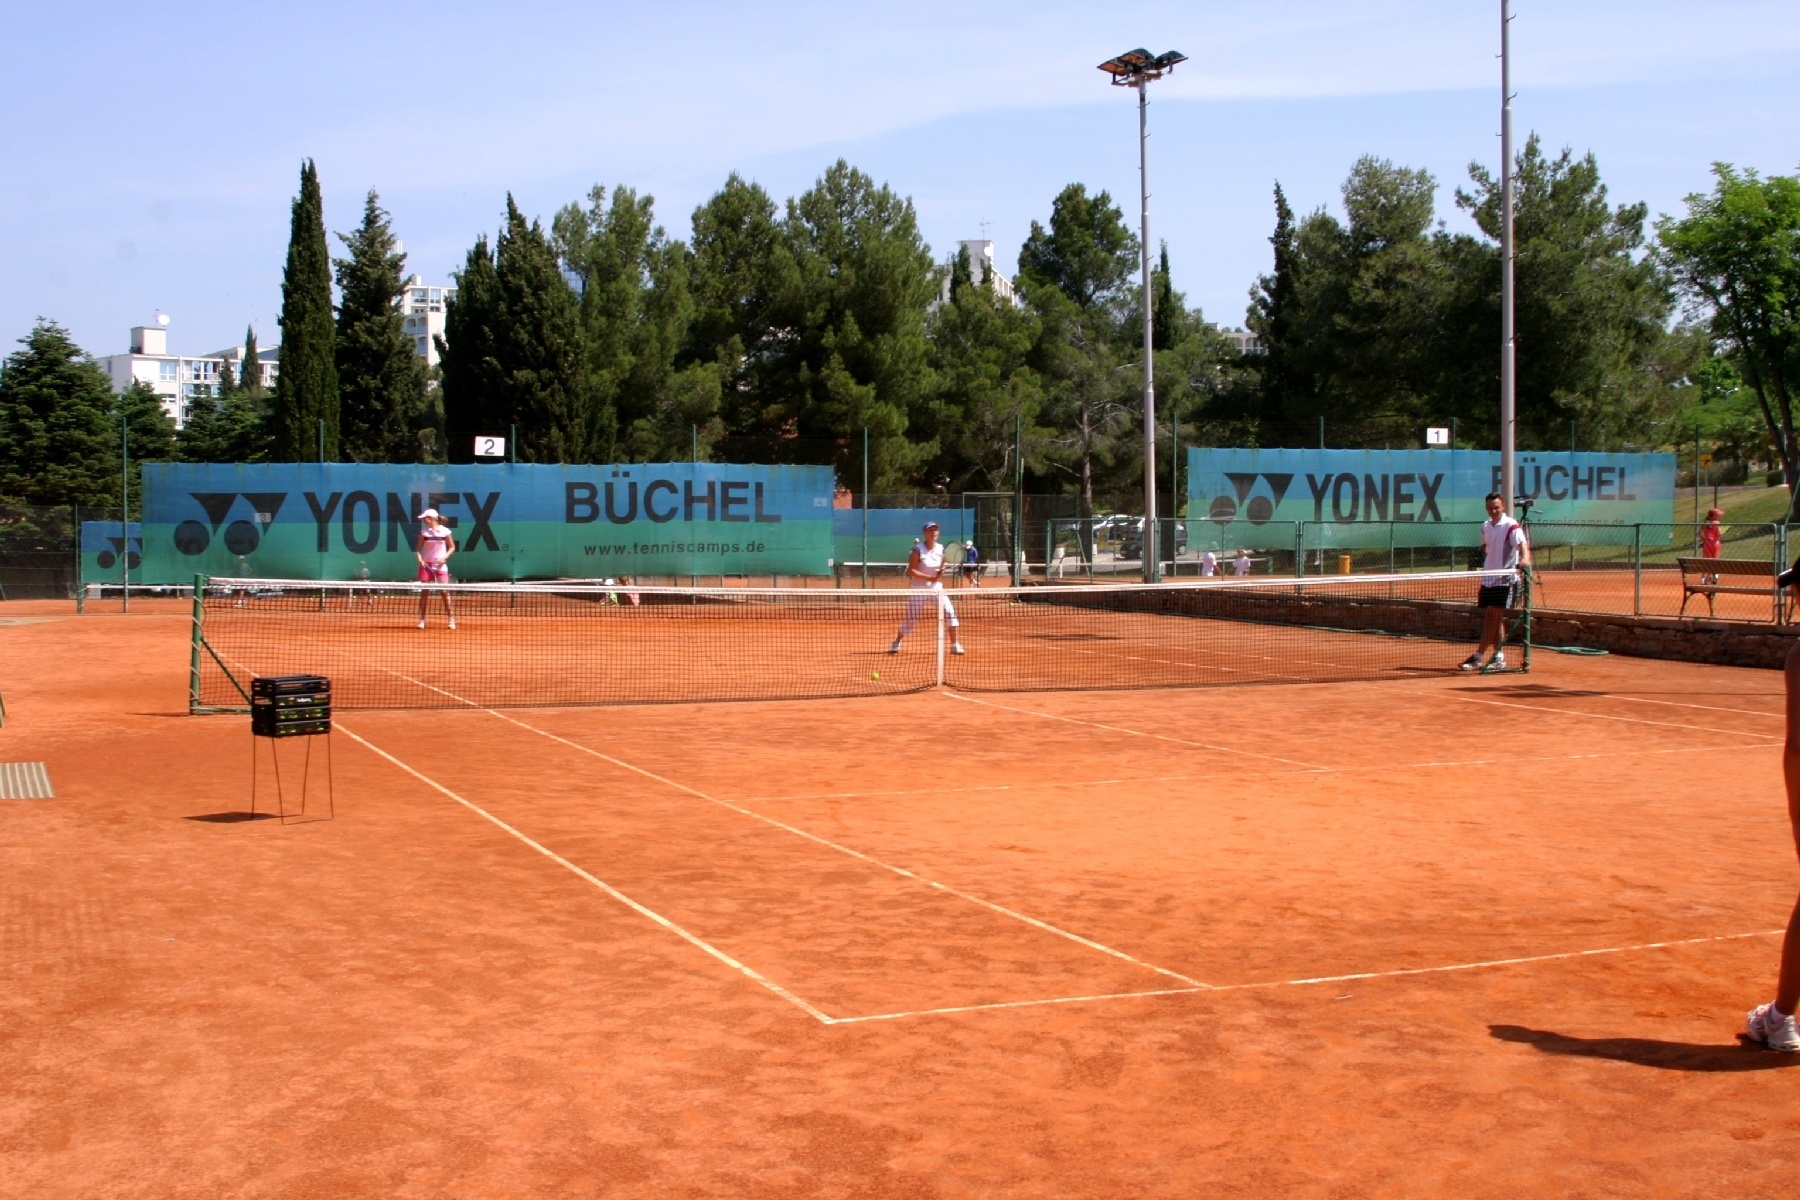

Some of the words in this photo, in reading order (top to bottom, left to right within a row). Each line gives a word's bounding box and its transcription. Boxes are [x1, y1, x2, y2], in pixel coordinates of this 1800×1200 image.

[1434, 430, 1440, 443] 1
[484, 439, 495, 455] 2
[1305, 472, 1445, 524] YONEX
[303, 490, 501, 554] YONEX
[565, 471, 781, 525] BÜCHEL
[584, 541, 766, 556] www.tenniscamps.de
